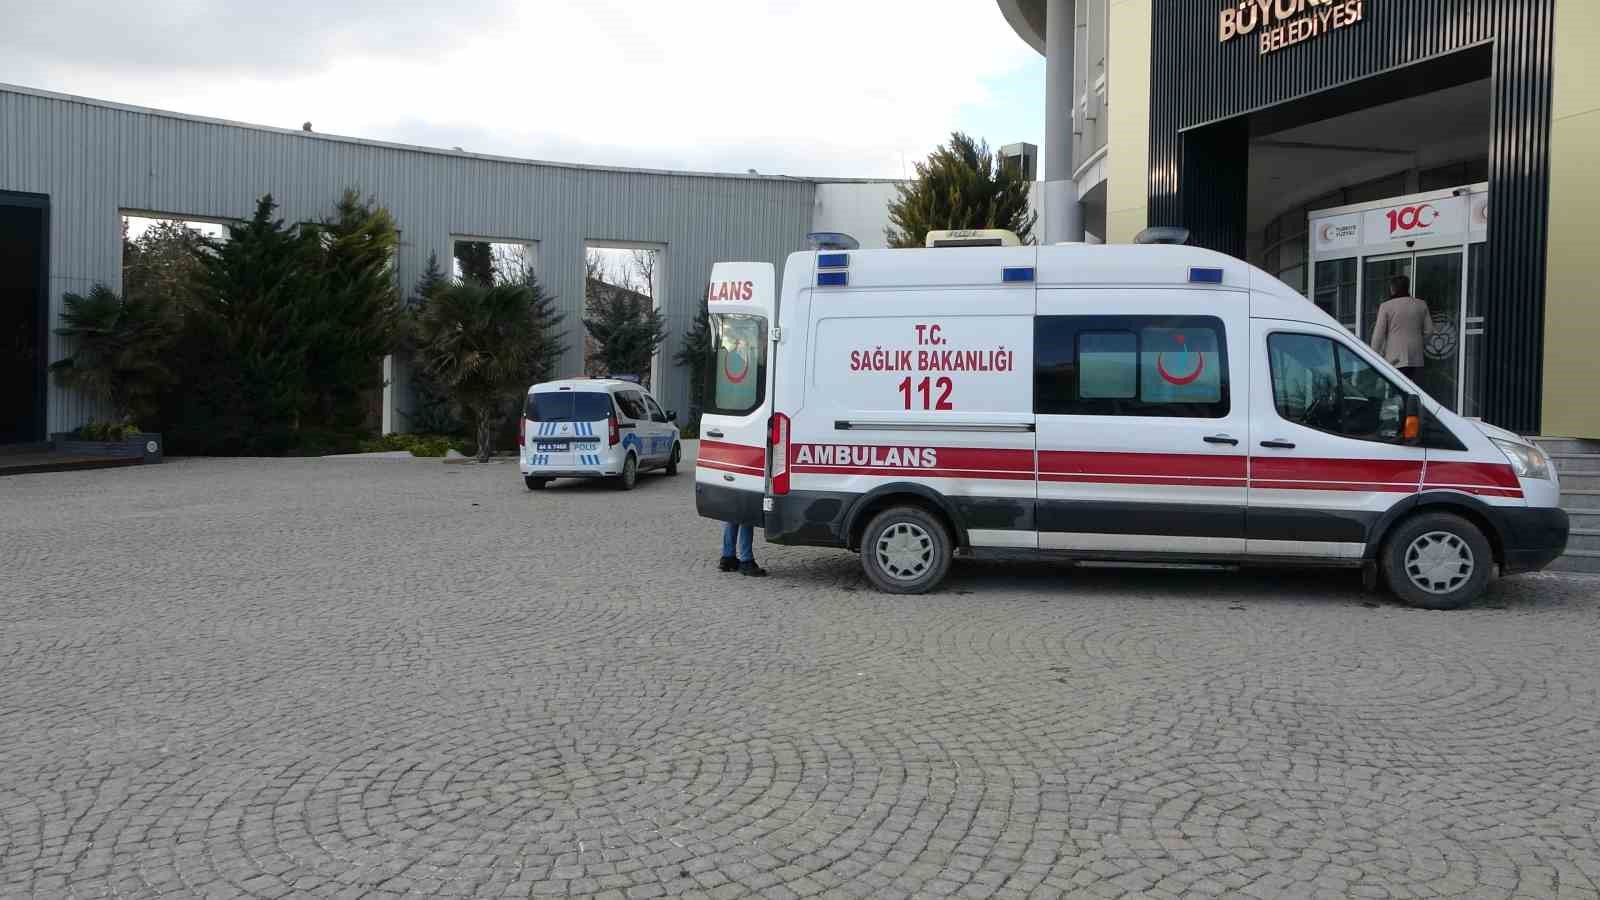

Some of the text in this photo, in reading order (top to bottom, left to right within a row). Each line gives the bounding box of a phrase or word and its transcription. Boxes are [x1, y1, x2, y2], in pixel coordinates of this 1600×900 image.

[709, 281, 753, 301] LANS
[915, 324, 947, 345] T.C.
[850, 346, 1013, 371] SAĞLIK BAKANLIĞI
[898, 377, 953, 410] 112
[796, 446, 937, 468] AMBULANS
